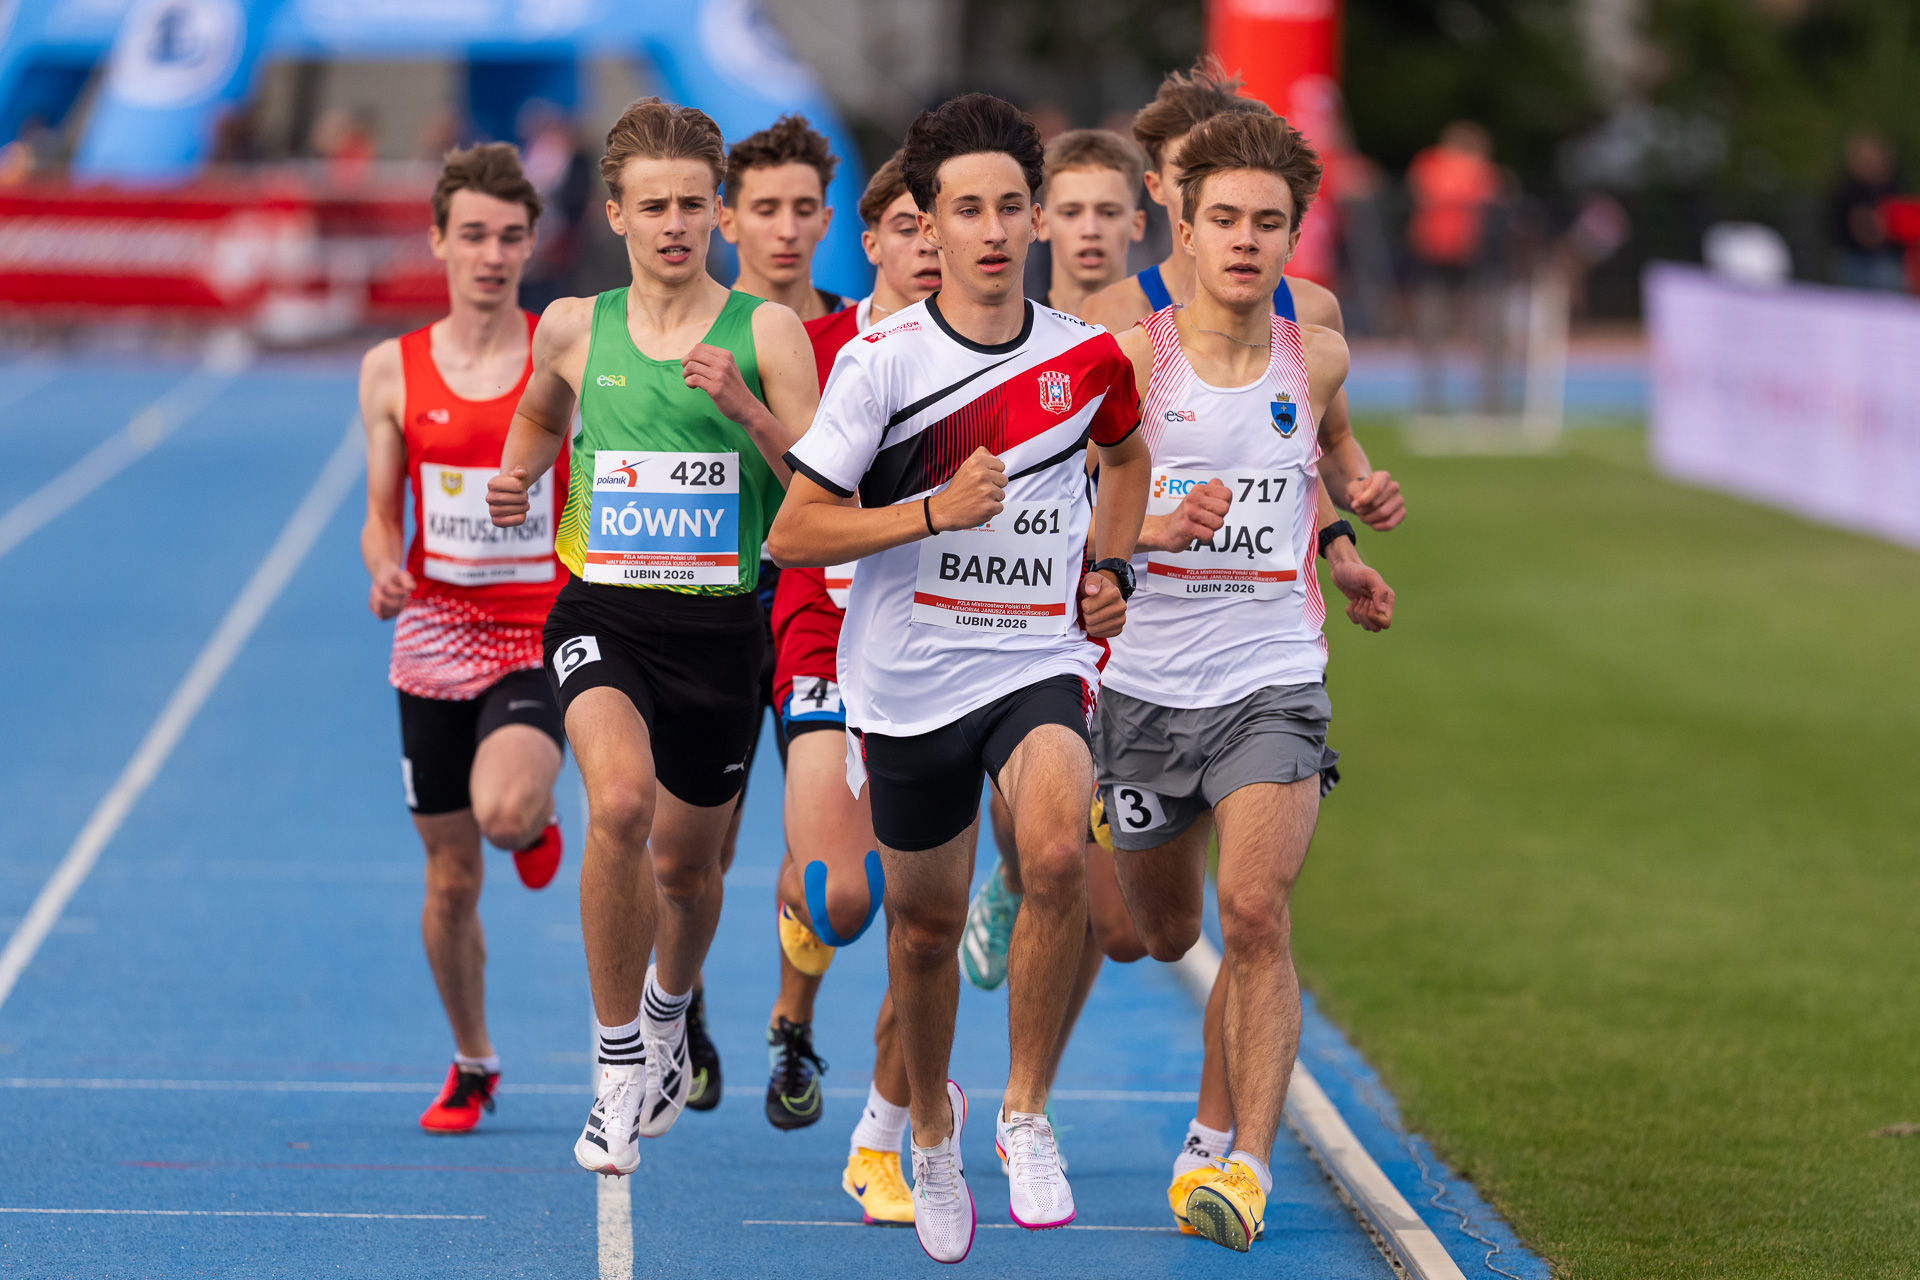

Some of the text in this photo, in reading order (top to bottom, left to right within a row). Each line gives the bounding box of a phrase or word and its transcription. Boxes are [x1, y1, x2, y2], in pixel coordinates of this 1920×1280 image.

[596, 374, 626, 387] esa
[1164, 410, 1196, 422] esa
[596, 475, 627, 486] polanik
[670, 461, 726, 486] 428
[1169, 479, 1208, 495] RC
[1237, 478, 1287, 503] 717
[601, 501, 725, 537] RÓWNY
[1013, 508, 1060, 535] 661
[1184, 525, 1275, 560] AJĄC
[624, 569, 695, 580] LUBIN 2026
[939, 552, 1053, 587] BARAN
[1186, 583, 1255, 594] LUBIN 2026
[952, 605, 980, 613] MEMORIAŁ
[955, 615, 1028, 629] LUBIN 2026
[561, 638, 588, 673] 5
[801, 677, 829, 708] 4
[1120, 788, 1152, 829] 3
